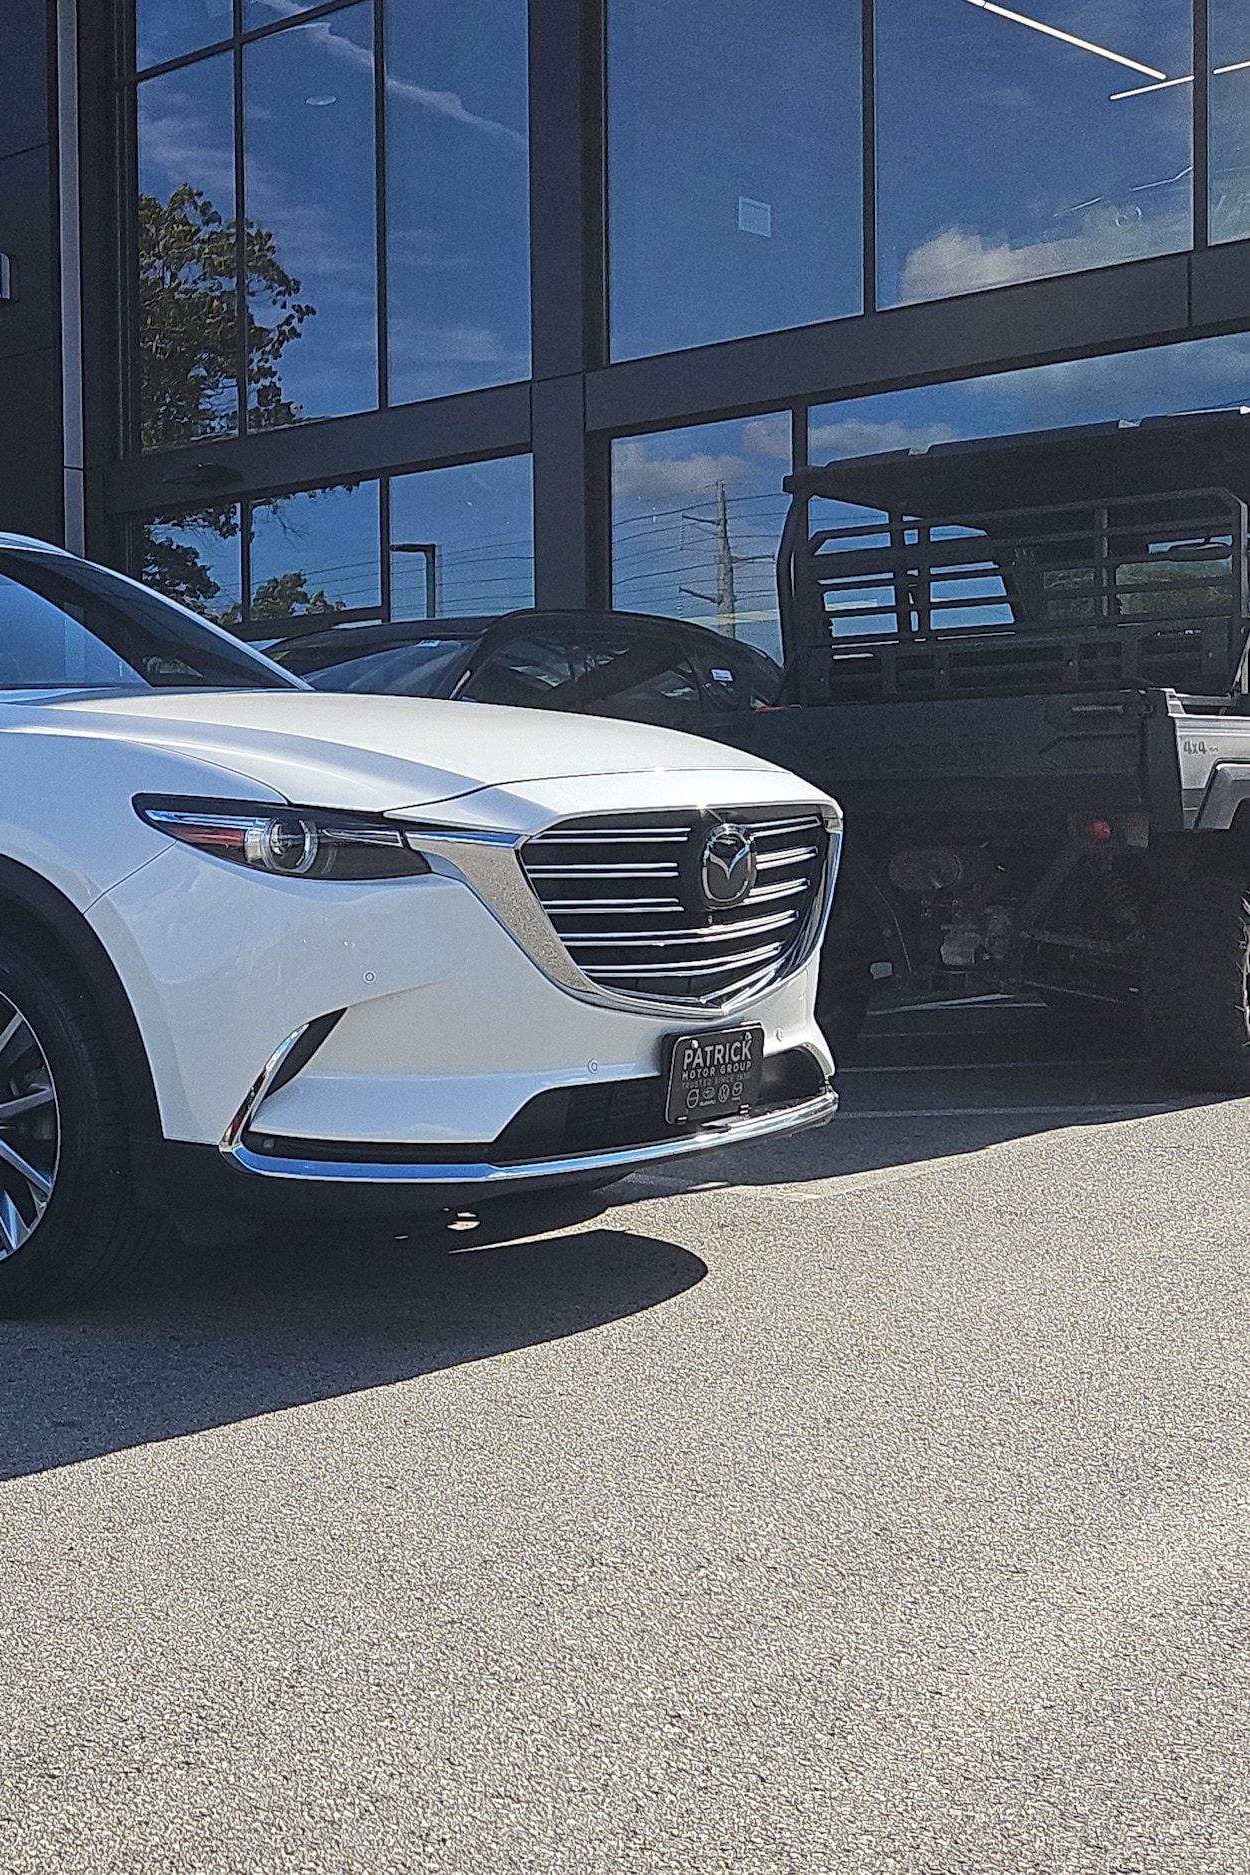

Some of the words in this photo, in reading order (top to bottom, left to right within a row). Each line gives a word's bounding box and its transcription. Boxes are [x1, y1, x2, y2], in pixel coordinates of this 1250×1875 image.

[1183, 740, 1207, 755] 4x4
[683, 1040, 752, 1070] PATRICK
[682, 1067, 715, 1081] MOTOR
[720, 1061, 752, 1075] GROUP
